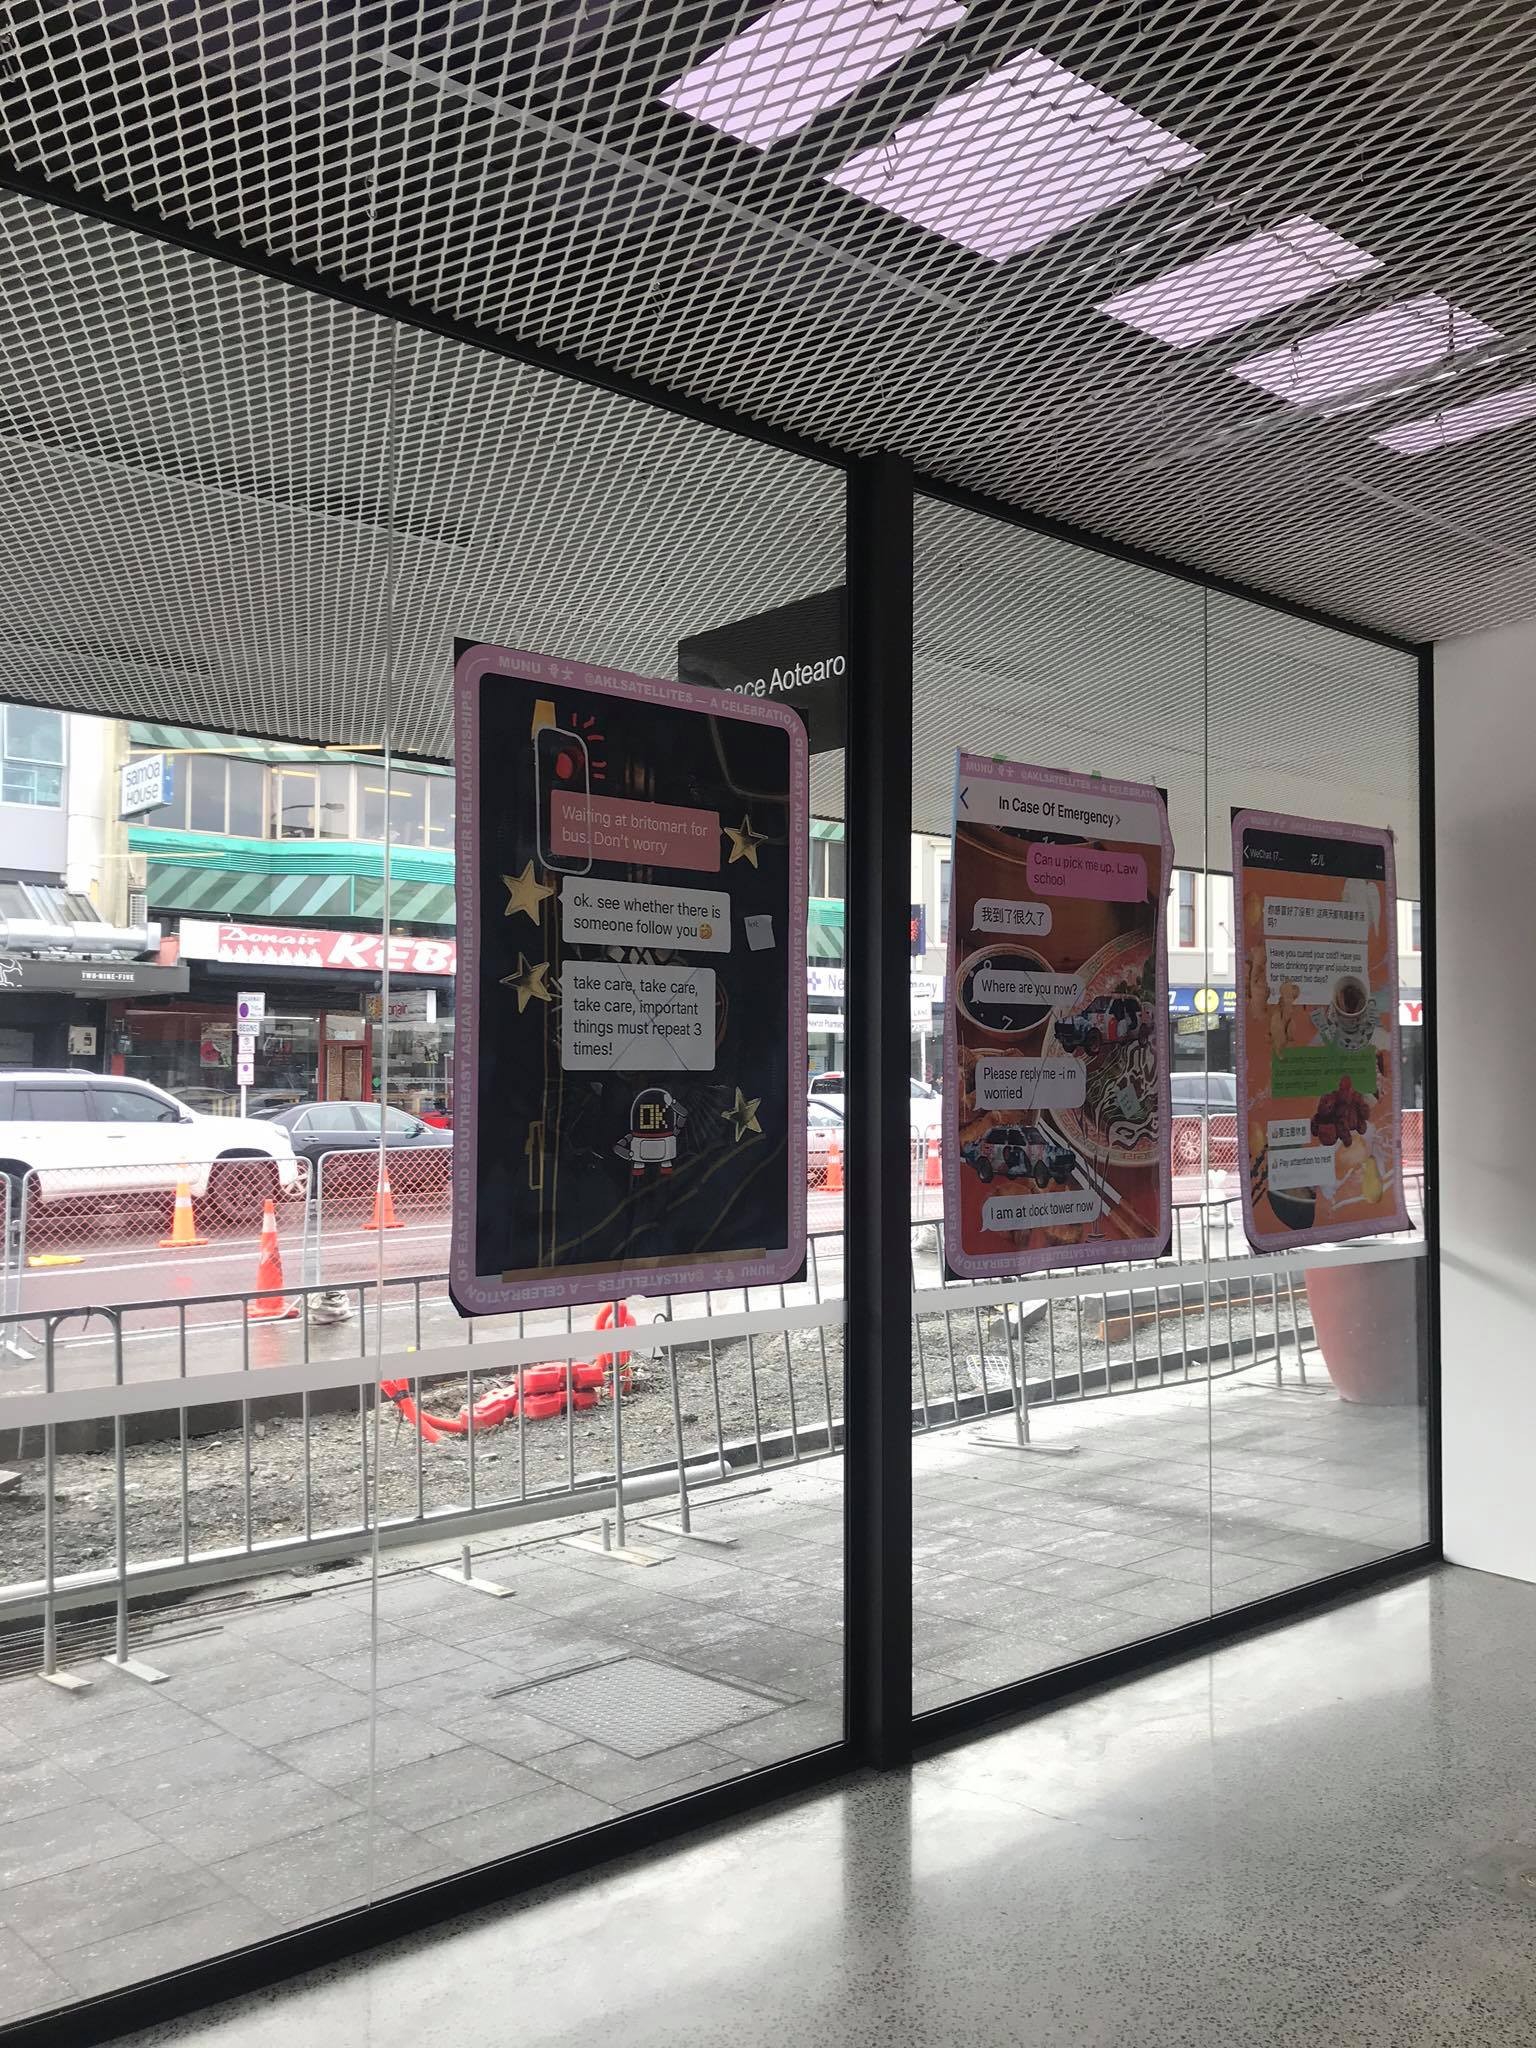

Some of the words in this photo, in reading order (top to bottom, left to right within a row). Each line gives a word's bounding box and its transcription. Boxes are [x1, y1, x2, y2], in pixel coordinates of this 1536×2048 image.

[499, 655, 541, 674] MUNU
[709, 698, 718, 708] A
[721, 701, 800, 733] CELEBRATION
[460, 689, 474, 824] RELATIONSHIPS
[562, 805, 611, 828] Waiting
[615, 814, 627, 826] at
[631, 814, 688, 835] britomart
[691, 821, 709, 837] for
[999, 796, 1010, 810] In
[1012, 797, 1040, 814] Case
[1042, 802, 1056, 816] Of
[1058, 804, 1114, 828] Emergency
[562, 827, 590, 844] bus.
[594, 831, 629, 849] Don't
[633, 840, 668, 856] worry
[1034, 852, 1053, 866] Can
[1063, 856, 1083, 870] pick
[1085, 862, 1099, 871] me
[1100, 863, 1114, 874] up.
[1117, 862, 1138, 875] Law
[1034, 872, 1066, 886] school
[460, 830, 474, 997] MOTHER-DAUGHTER
[573, 893, 593, 908] ok.
[597, 897, 620, 910] see
[624, 897, 674, 914] whether
[677, 902, 709, 918] there
[711, 905, 721, 919] is
[981, 906, 1045, 926] 我到了很久了
[573, 917, 633, 932] someone
[635, 919, 673, 935] follow
[676, 926, 698, 939] you
[220, 926, 321, 945] Donair
[328, 933, 456, 973] KEB
[81, 972, 135, 981] TWO-NINE-FIVE
[573, 976, 601, 990] take
[604, 979, 636, 995] care,
[639, 979, 667, 993] take
[670, 982, 698, 997] care,
[981, 979, 1016, 993] Where
[1018, 983, 1033, 993] are
[1034, 984, 1051, 997] you
[1053, 983, 1078, 996] now?
[573, 998, 601, 1012] take
[604, 1000, 636, 1016] care,
[639, 1000, 699, 1017] important
[460, 1003, 473, 1055] ASIAN
[573, 1019, 614, 1037] things
[617, 1022, 648, 1035] must
[652, 1023, 690, 1038] repeat
[693, 1022, 702, 1036] 3
[573, 1041, 613, 1056] times!
[983, 1067, 1018, 1080] Please
[1020, 1067, 1041, 1083] reply
[1042, 1070, 1056, 1079] me
[984, 1086, 1023, 1100] worried
[459, 1059, 473, 1161] SOUTHEAST
[639, 1104, 669, 1130] OK
[1279, 1158, 1289, 1168] Pay
[458, 1168, 470, 1203] AND
[990, 1207, 994, 1220] I
[996, 1208, 1014, 1220] am
[1015, 1206, 1027, 1218] at
[1050, 1202, 1073, 1215] tower
[1076, 1201, 1094, 1212] now
[458, 1209, 469, 1253] EAST
